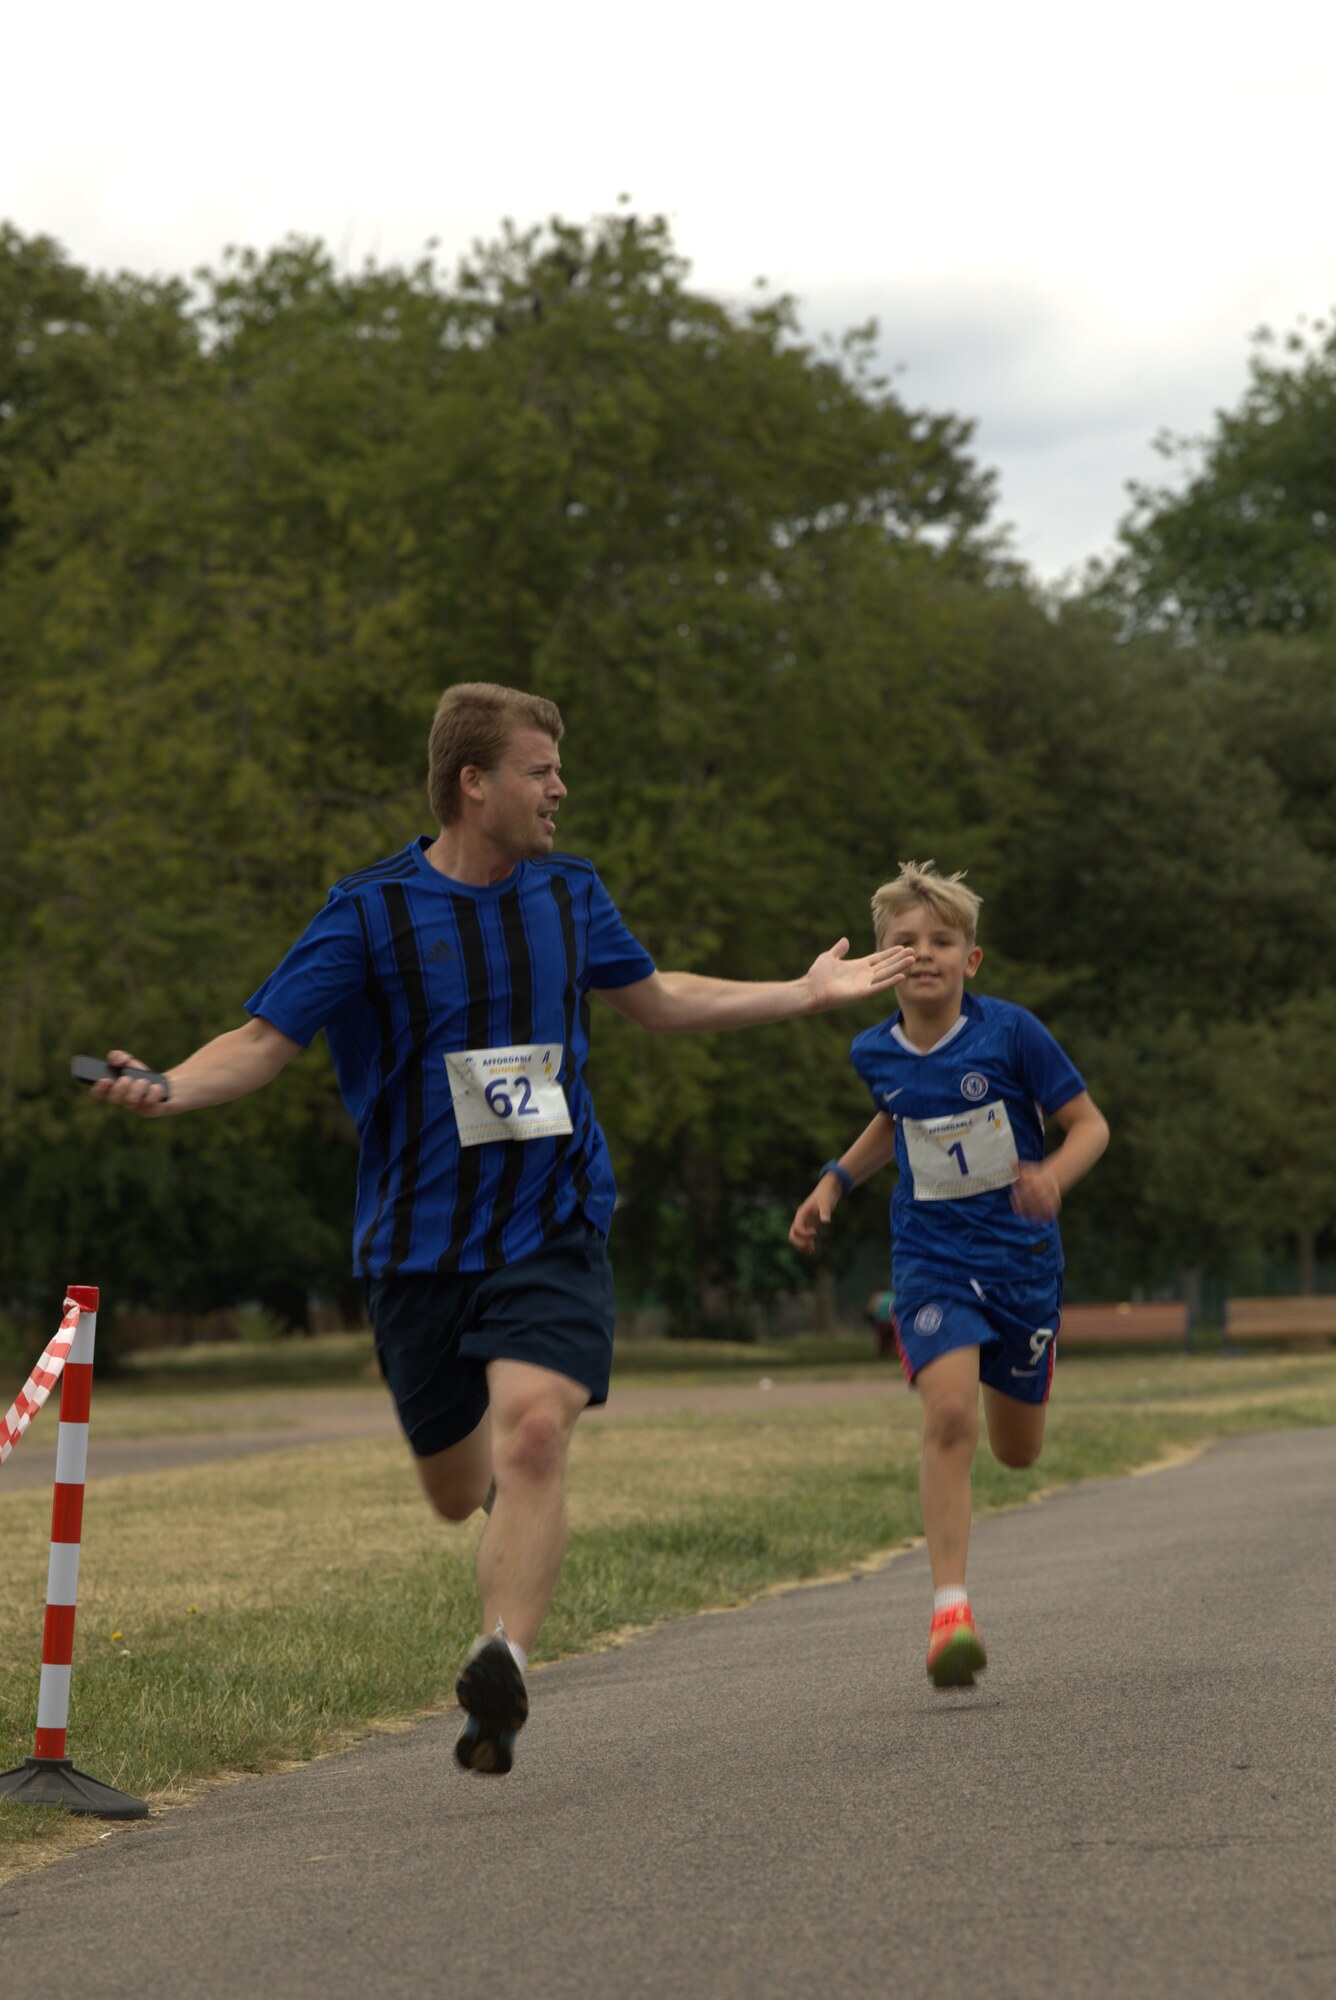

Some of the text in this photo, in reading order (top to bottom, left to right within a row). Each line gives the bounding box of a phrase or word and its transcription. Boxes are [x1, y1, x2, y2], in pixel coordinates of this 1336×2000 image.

[483, 1055, 531, 1066] AFFORDABLE
[484, 1076, 539, 1119] 62
[947, 1141, 969, 1177] 1
[1030, 1328, 1053, 1366] 9
